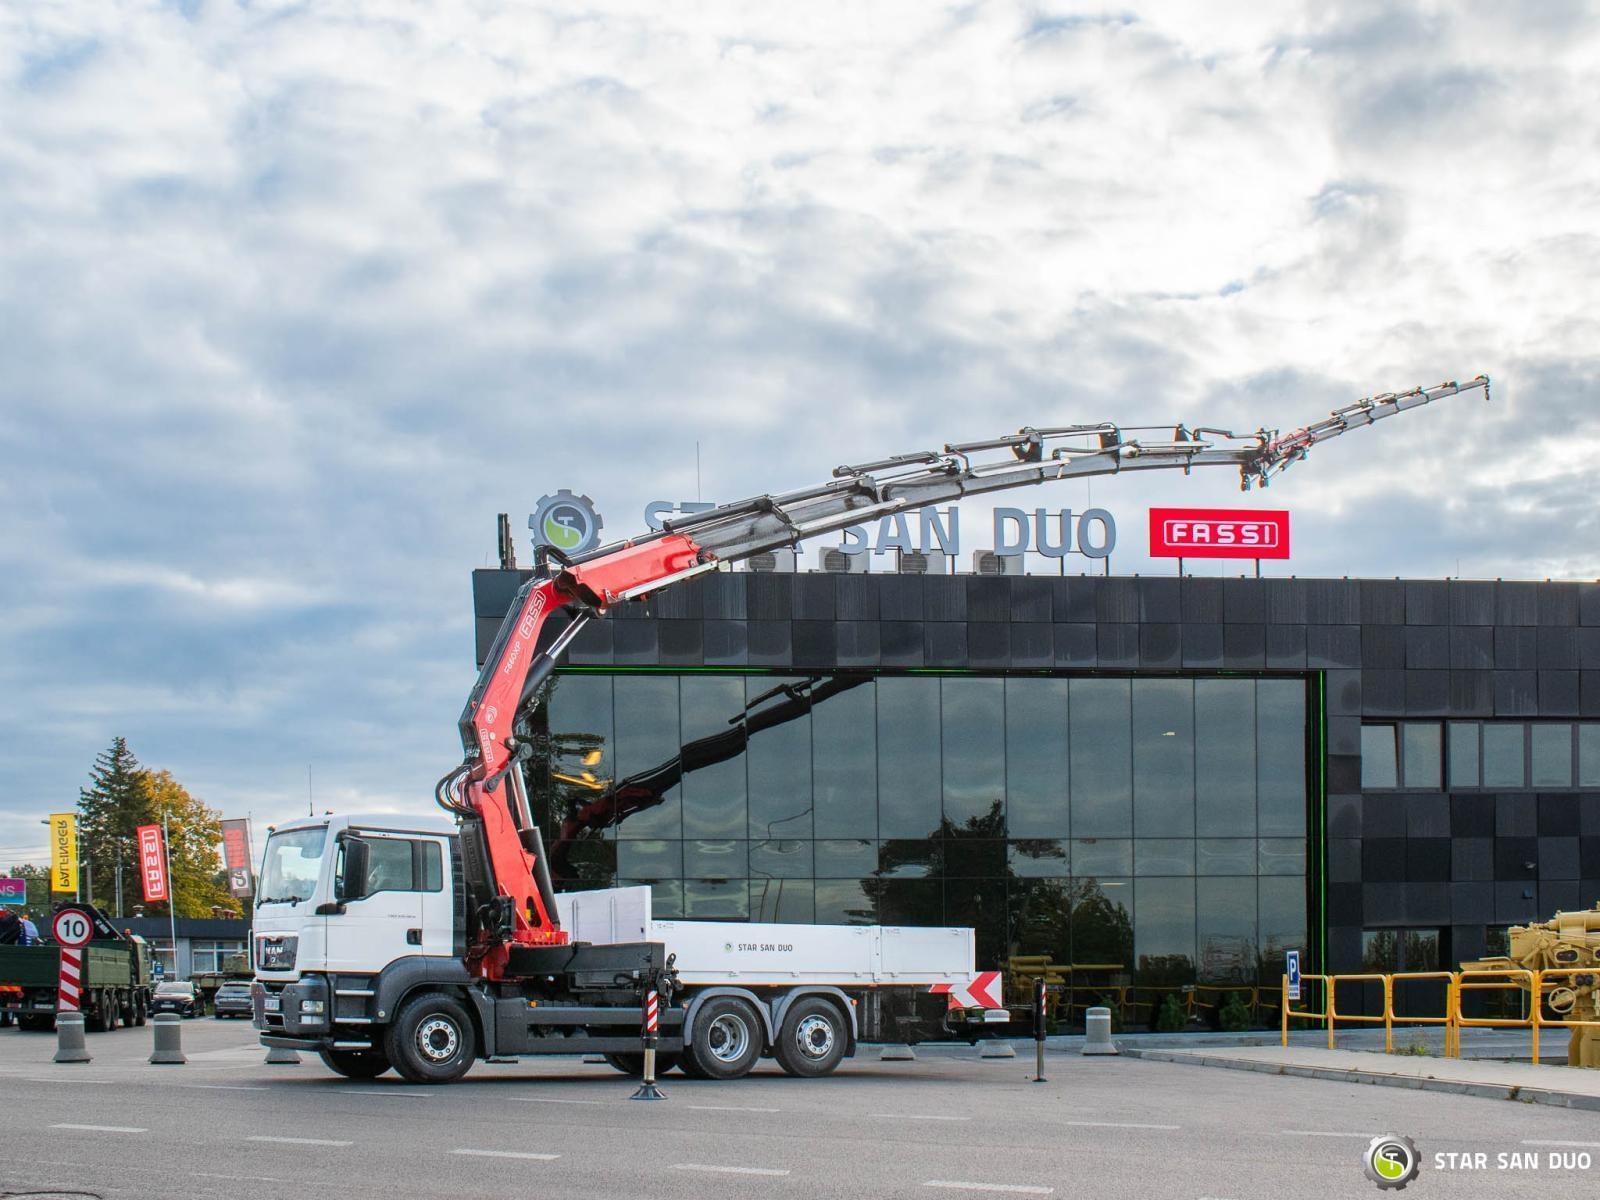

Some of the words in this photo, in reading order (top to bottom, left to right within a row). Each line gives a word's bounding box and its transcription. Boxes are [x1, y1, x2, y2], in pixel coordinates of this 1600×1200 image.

[993, 507, 1117, 558] DUO
[1172, 523, 1270, 544] FASSI
[521, 592, 545, 637] FASSI
[63, 919, 85, 938] 10
[738, 943, 758, 952] STAR
[760, 943, 775, 952] SAN
[777, 943, 793, 952] DUO
